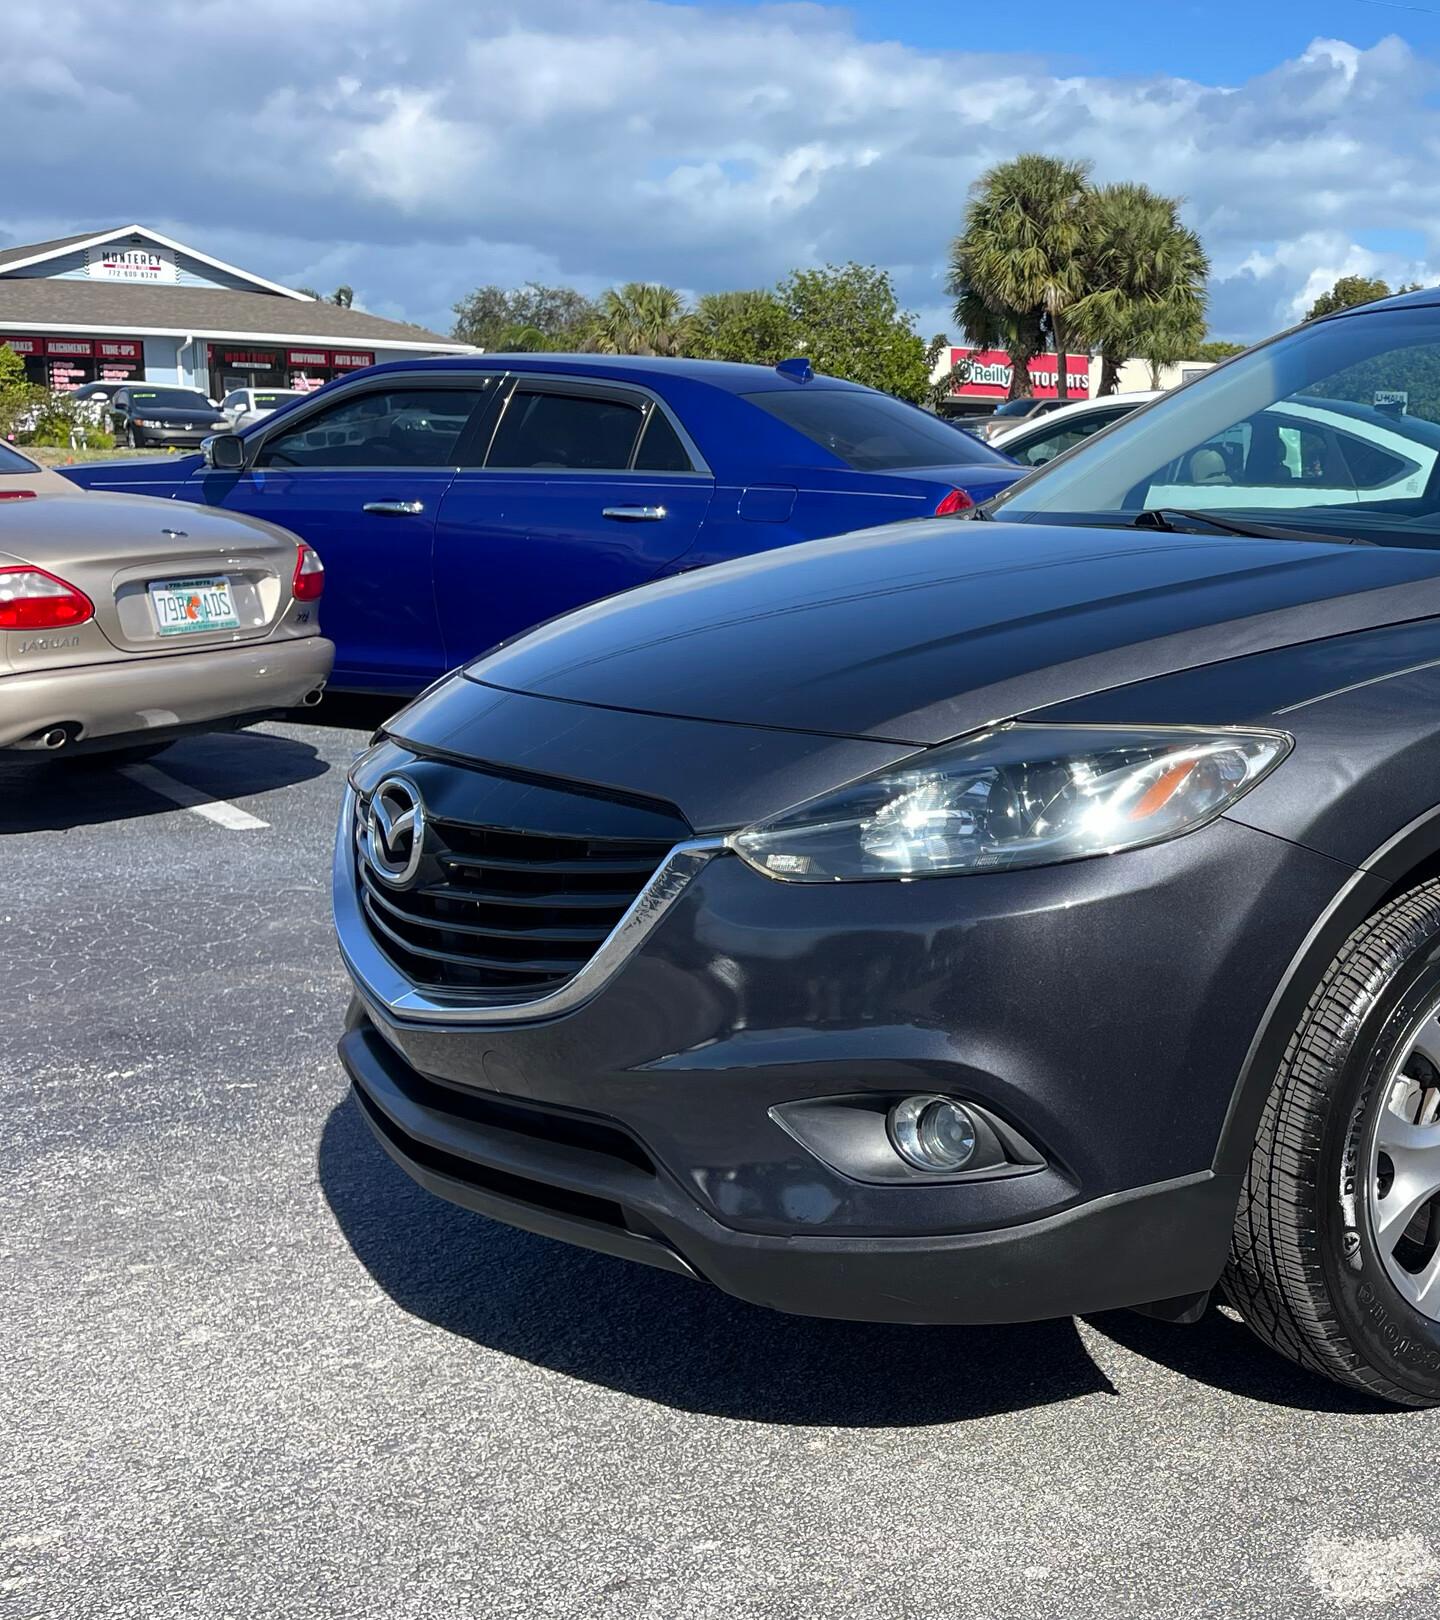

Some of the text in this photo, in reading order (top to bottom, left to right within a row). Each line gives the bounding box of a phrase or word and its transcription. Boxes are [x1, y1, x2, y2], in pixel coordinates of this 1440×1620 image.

[102, 251, 161, 265] MONTEREY
[1051, 372, 1089, 388] PRTS
[17, 636, 80, 653] JAGUAR
